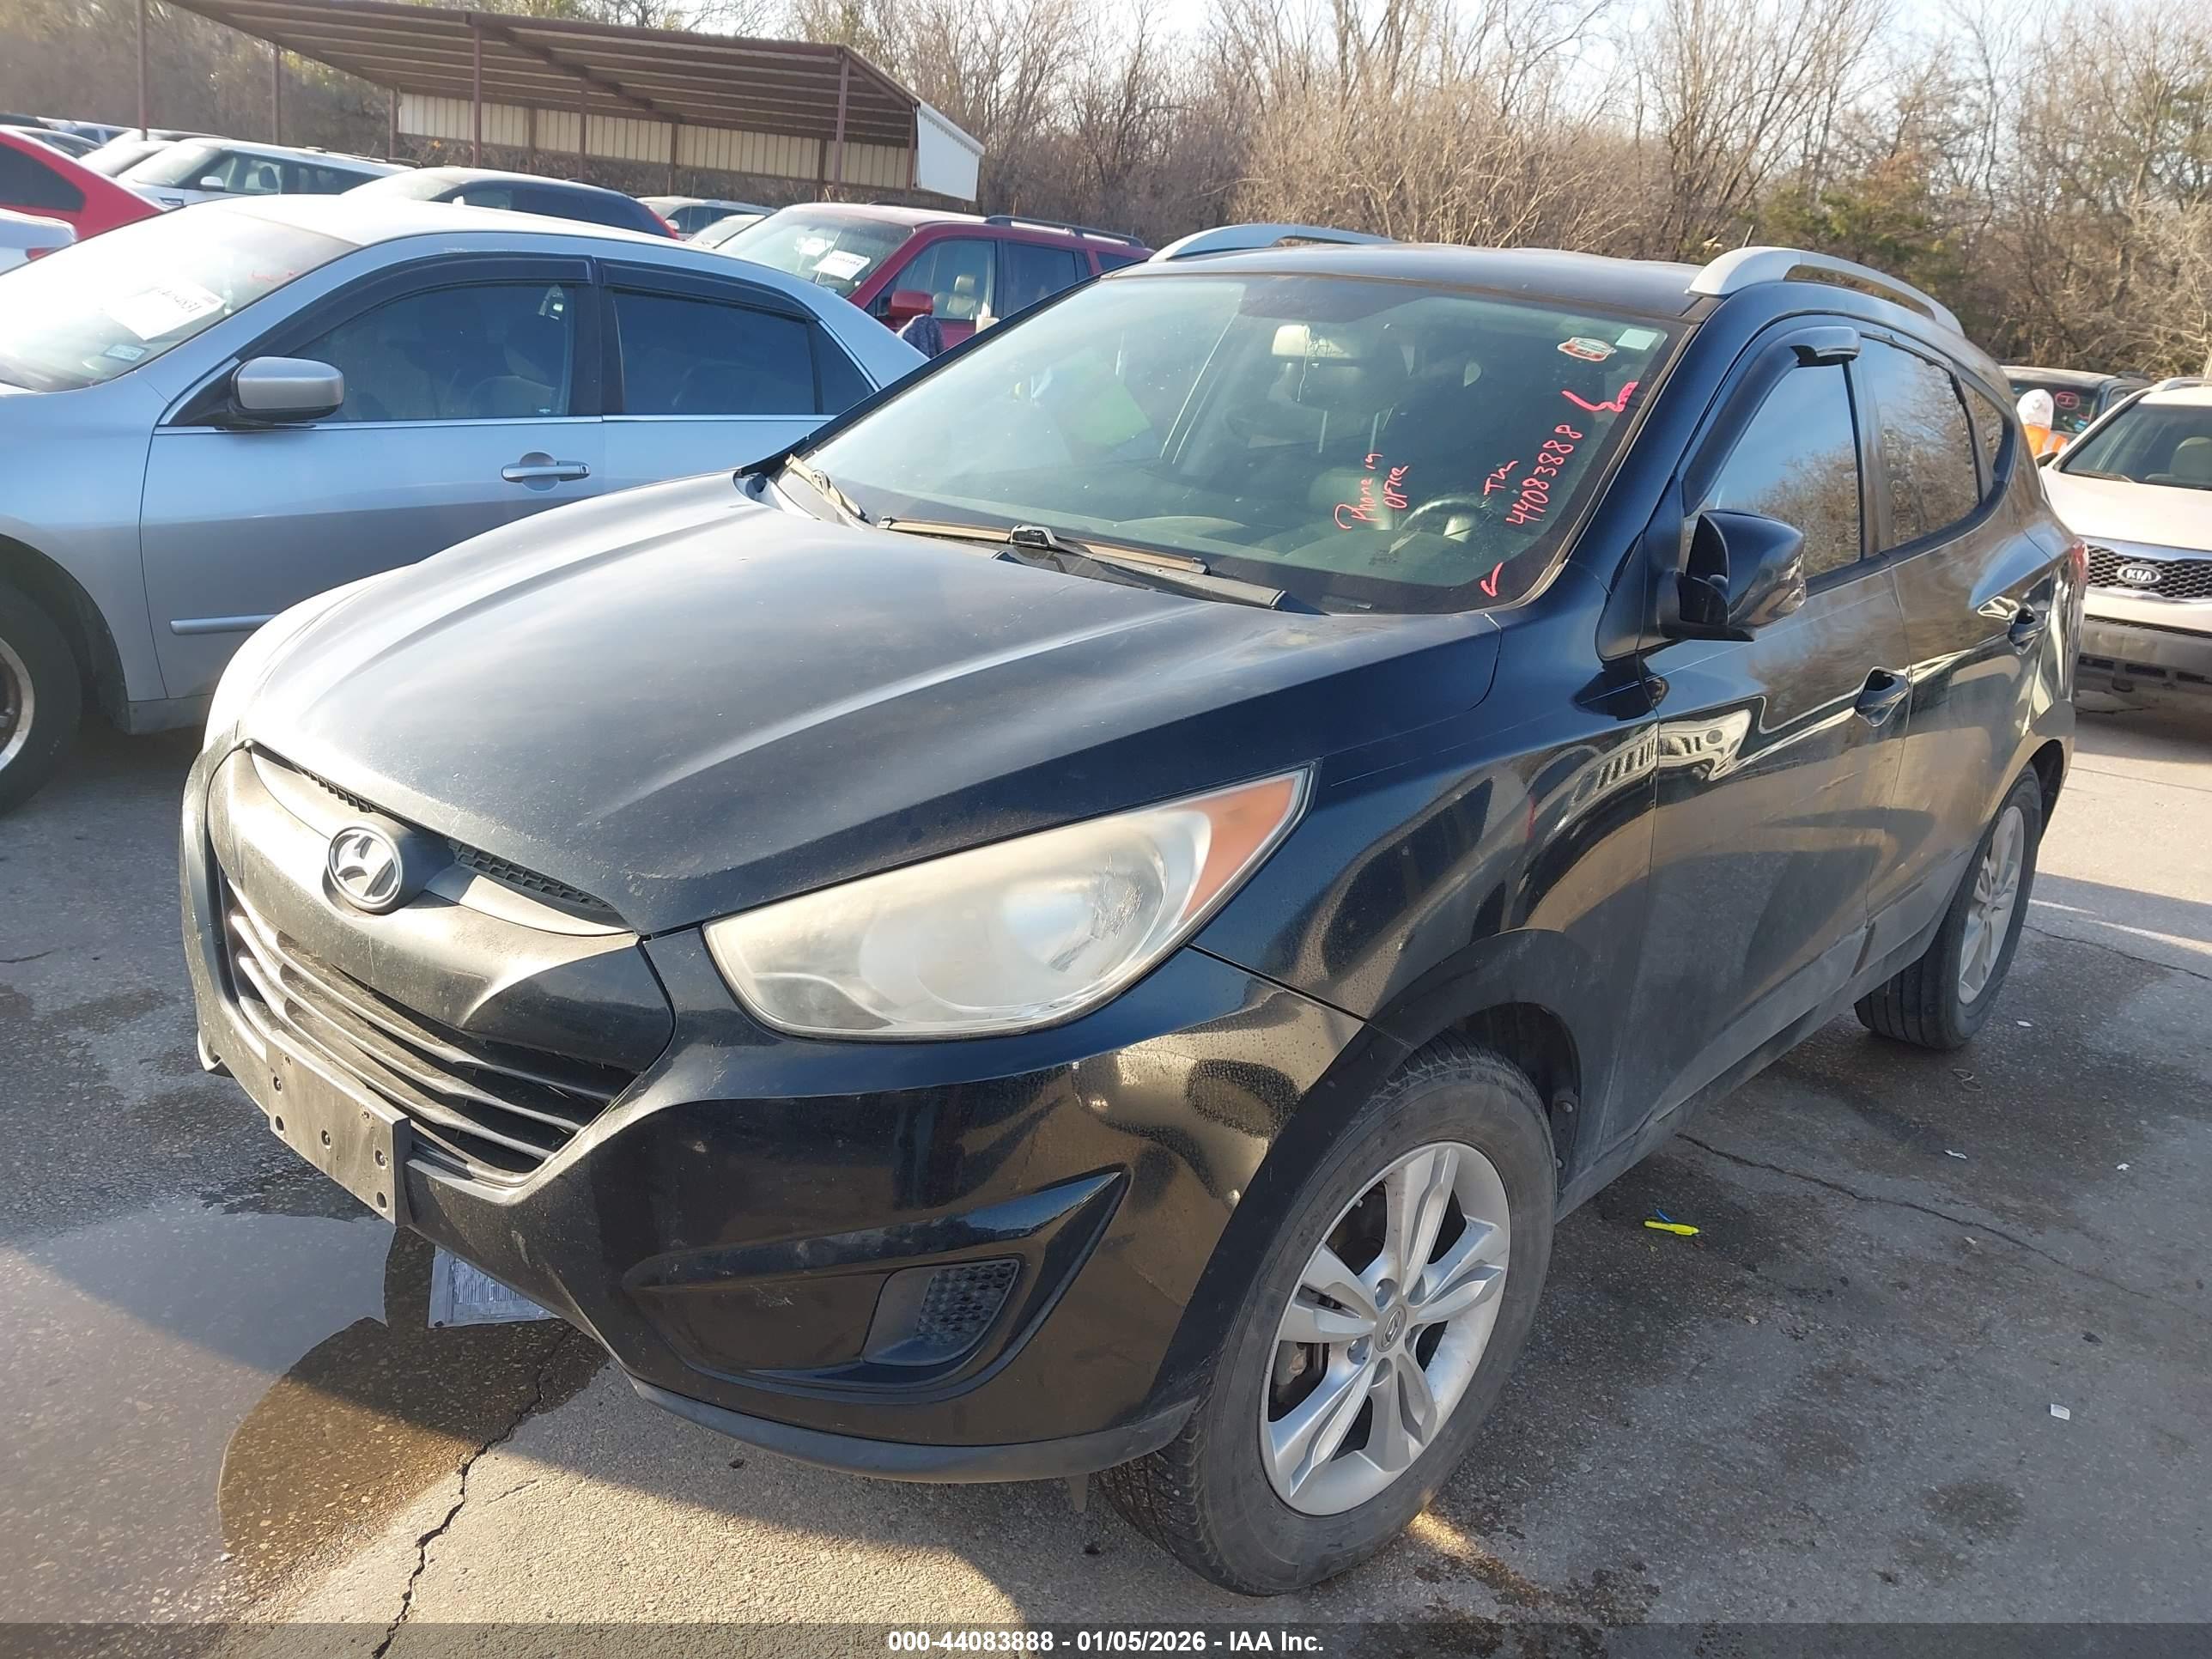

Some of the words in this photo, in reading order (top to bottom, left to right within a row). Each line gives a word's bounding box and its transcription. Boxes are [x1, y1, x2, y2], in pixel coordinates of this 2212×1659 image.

[1506, 424, 1583, 526] 44083888
[1334, 477, 1382, 529] Phone
[2126, 568, 2152, 581] KIA
